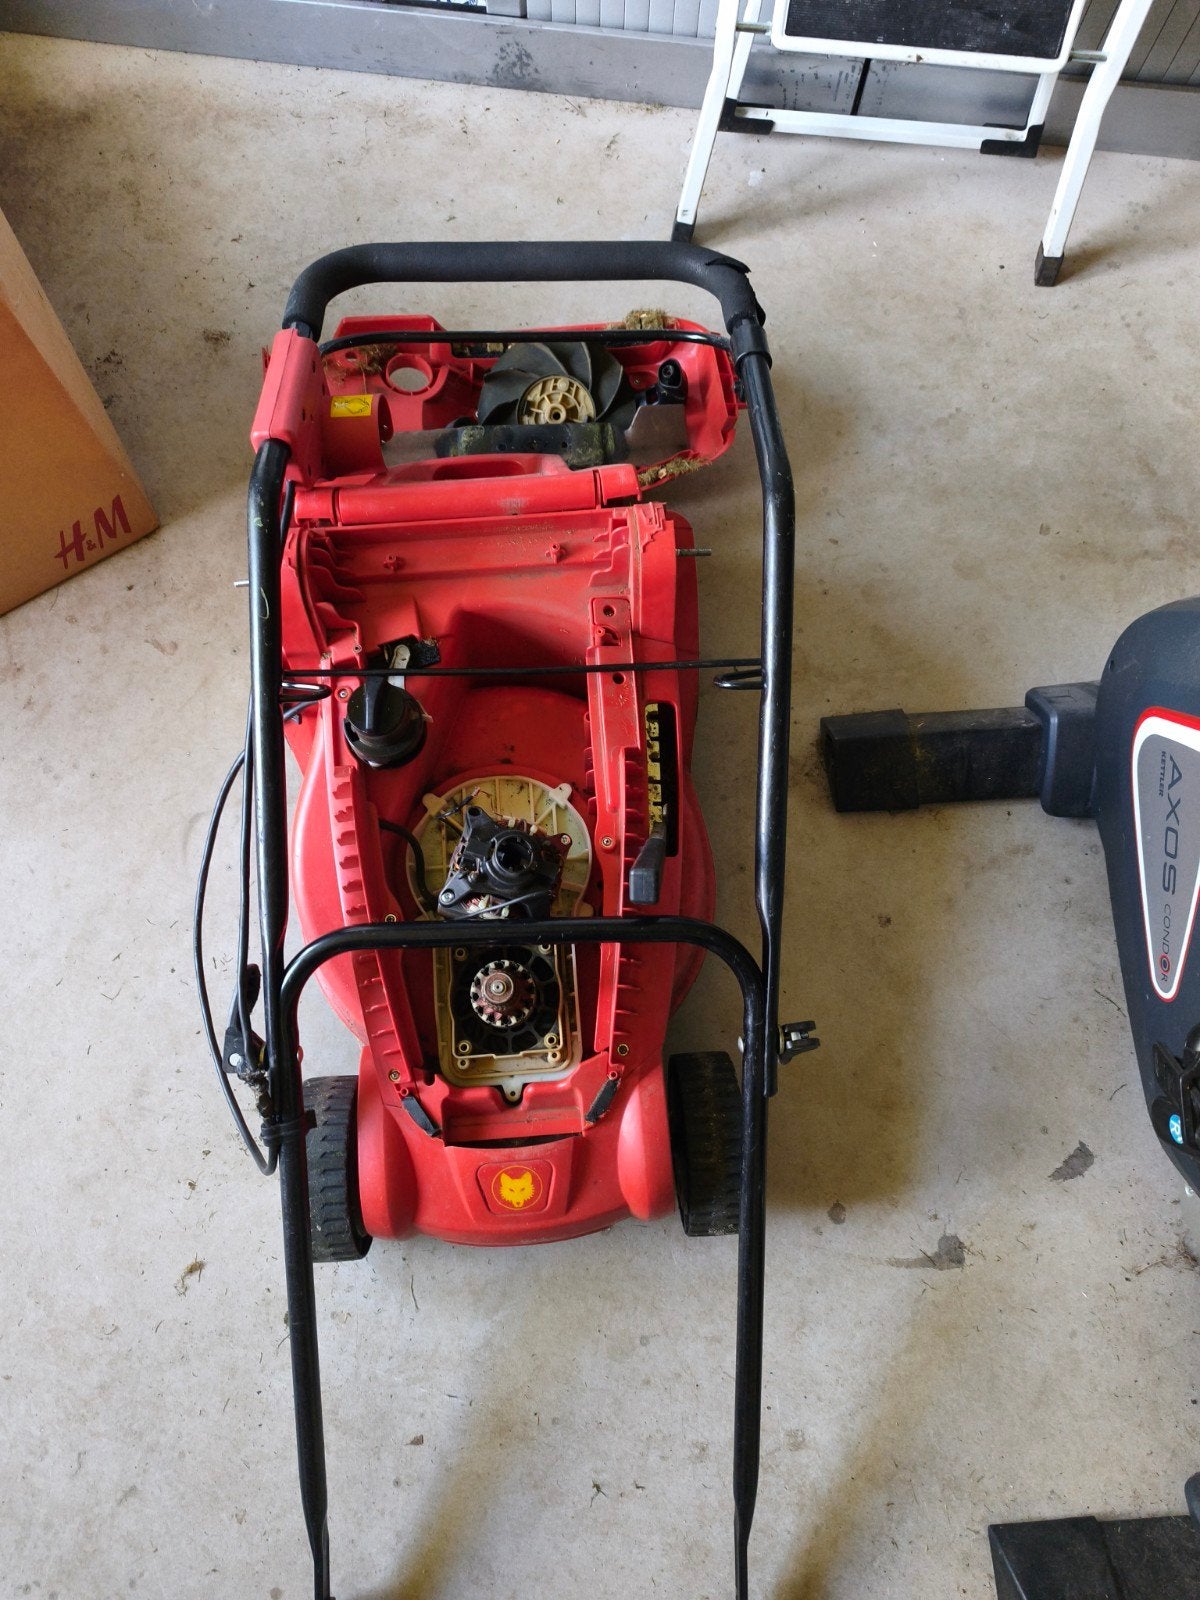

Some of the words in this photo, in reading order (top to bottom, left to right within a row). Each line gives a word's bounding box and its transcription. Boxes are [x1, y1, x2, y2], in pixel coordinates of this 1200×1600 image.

[54, 494, 132, 570] H&M
[1158, 750, 1166, 797] KETTLER
[1162, 754, 1182, 895] AXOS
[1160, 903, 1171, 982] CONDOR
